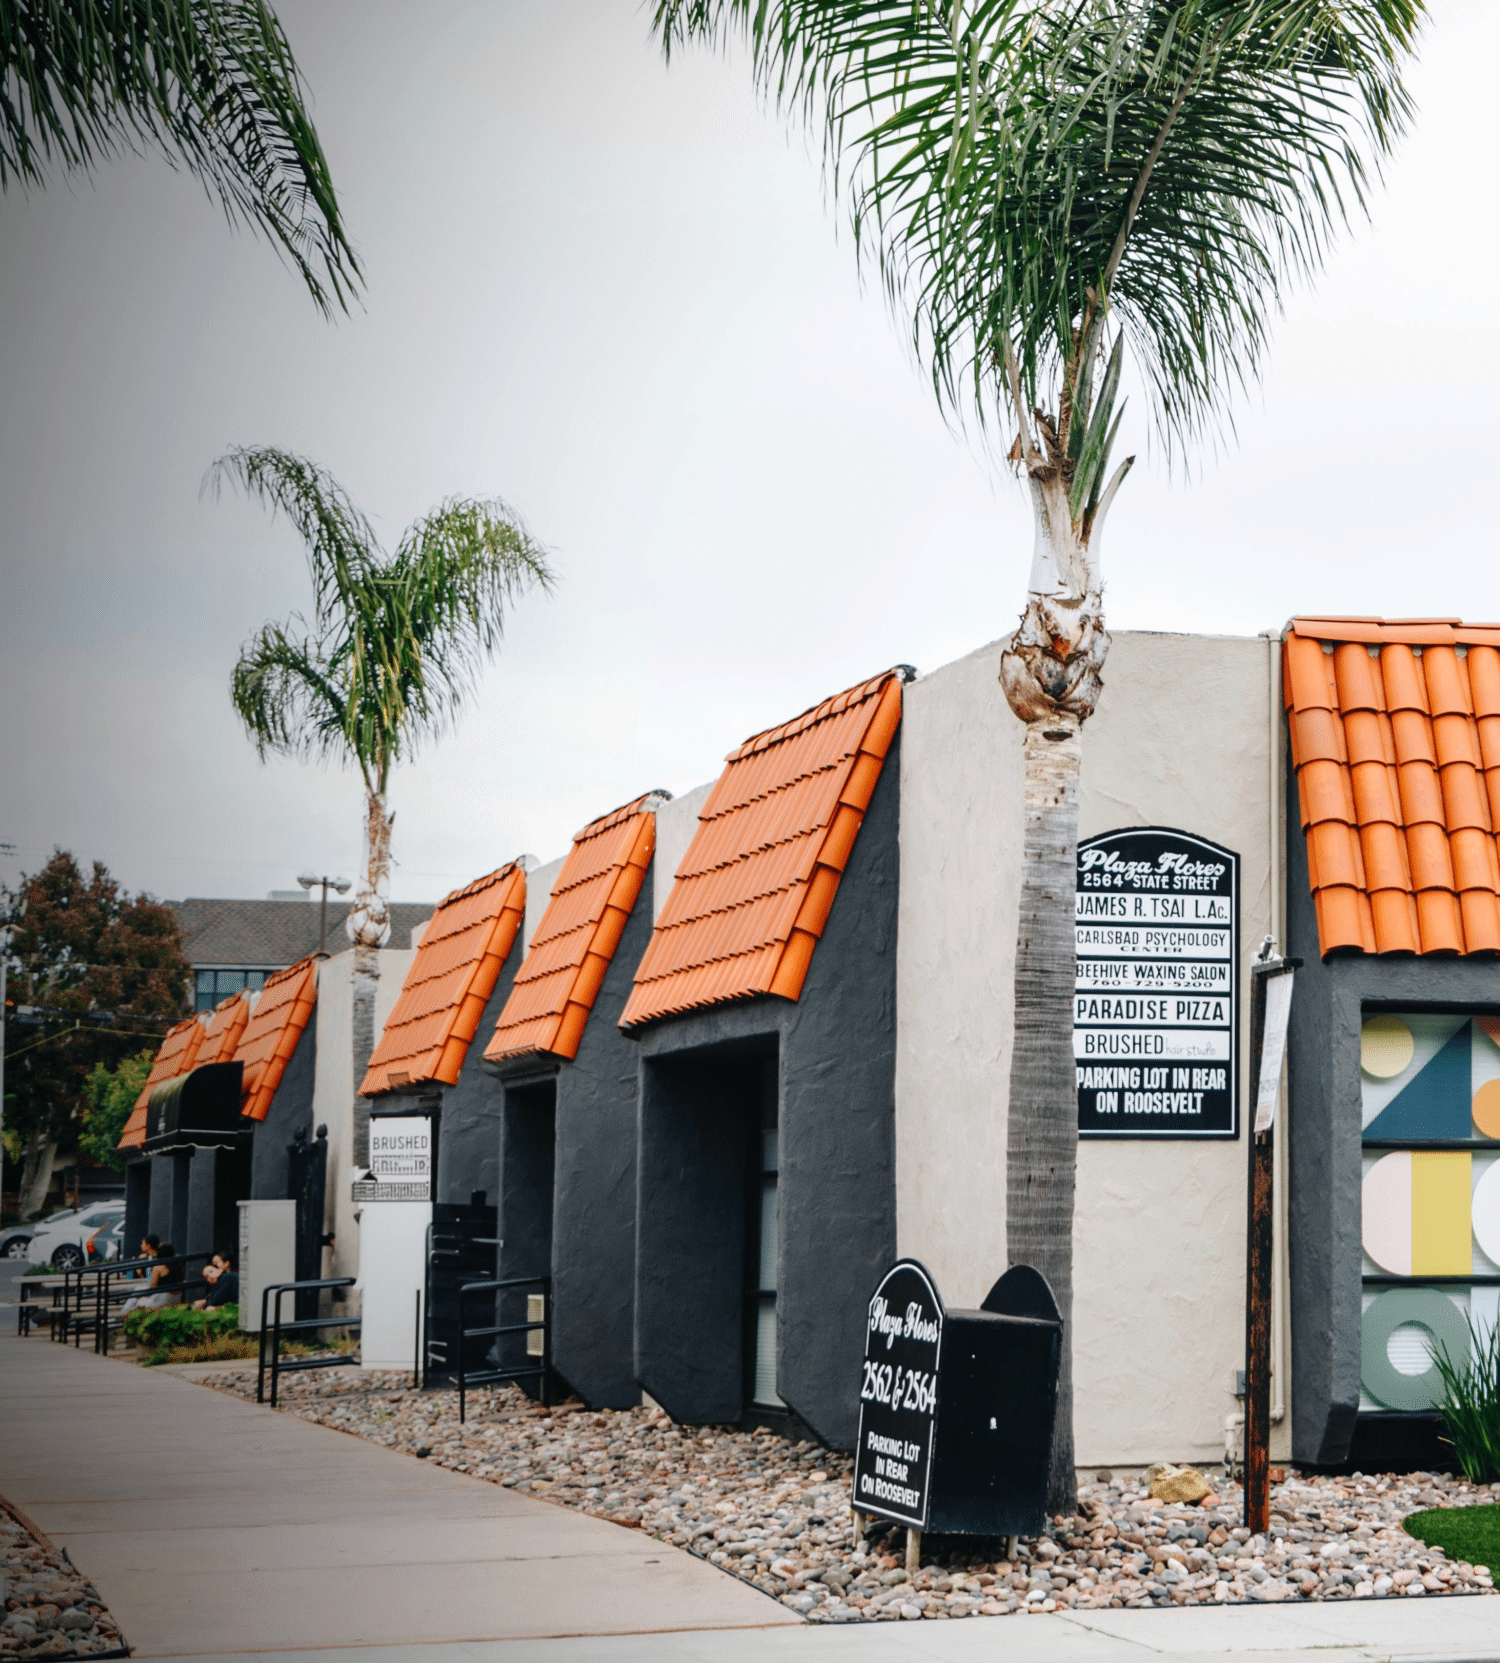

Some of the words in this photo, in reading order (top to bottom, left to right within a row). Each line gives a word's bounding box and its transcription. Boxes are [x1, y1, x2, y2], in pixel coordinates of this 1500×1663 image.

[1077, 849, 1153, 881] Plaza
[1154, 852, 1226, 877] Flores
[1083, 873, 1124, 888] 2564
[1132, 874, 1169, 889] STATE
[1173, 875, 1219, 891] STREET
[1077, 896, 1127, 917] JAMES
[1134, 897, 1147, 917] R.
[1151, 898, 1185, 918] TSAI
[1077, 930, 1139, 945] CARLSBAD
[1146, 931, 1226, 947] PSYCHOLOGY
[1076, 963, 1129, 979] BEEHIVE
[1134, 964, 1186, 980] WAXING
[1191, 966, 1226, 981] SALON
[1090, 979, 1213, 988] 760-729-5200
[1077, 999, 1168, 1020] PARADISE
[1176, 1001, 1224, 1021] PIZZA
[1085, 1034, 1164, 1054] BRUSHED
[1076, 1066, 1141, 1089] PARKING
[1143, 1067, 1169, 1090] LOT
[1172, 1068, 1190, 1090] IN
[1192, 1068, 1226, 1090] REAR
[1096, 1091, 1118, 1113] ON
[1124, 1092, 1204, 1114] ROOSEVELT
[373, 1135, 428, 1150] BRUSHED
[870, 1296, 903, 1350] Plaza
[903, 1301, 938, 1343] Flores
[861, 1360, 892, 1404] 2562
[892, 1365, 906, 1412] &
[903, 1369, 937, 1415] 2564
[867, 1431, 903, 1458] PARKING
[903, 1440, 921, 1463] LOT
[875, 1455, 885, 1475] IN
[886, 1458, 908, 1483] REAR
[861, 1473, 875, 1495] ON
[875, 1477, 920, 1509] ROOSEVELT
